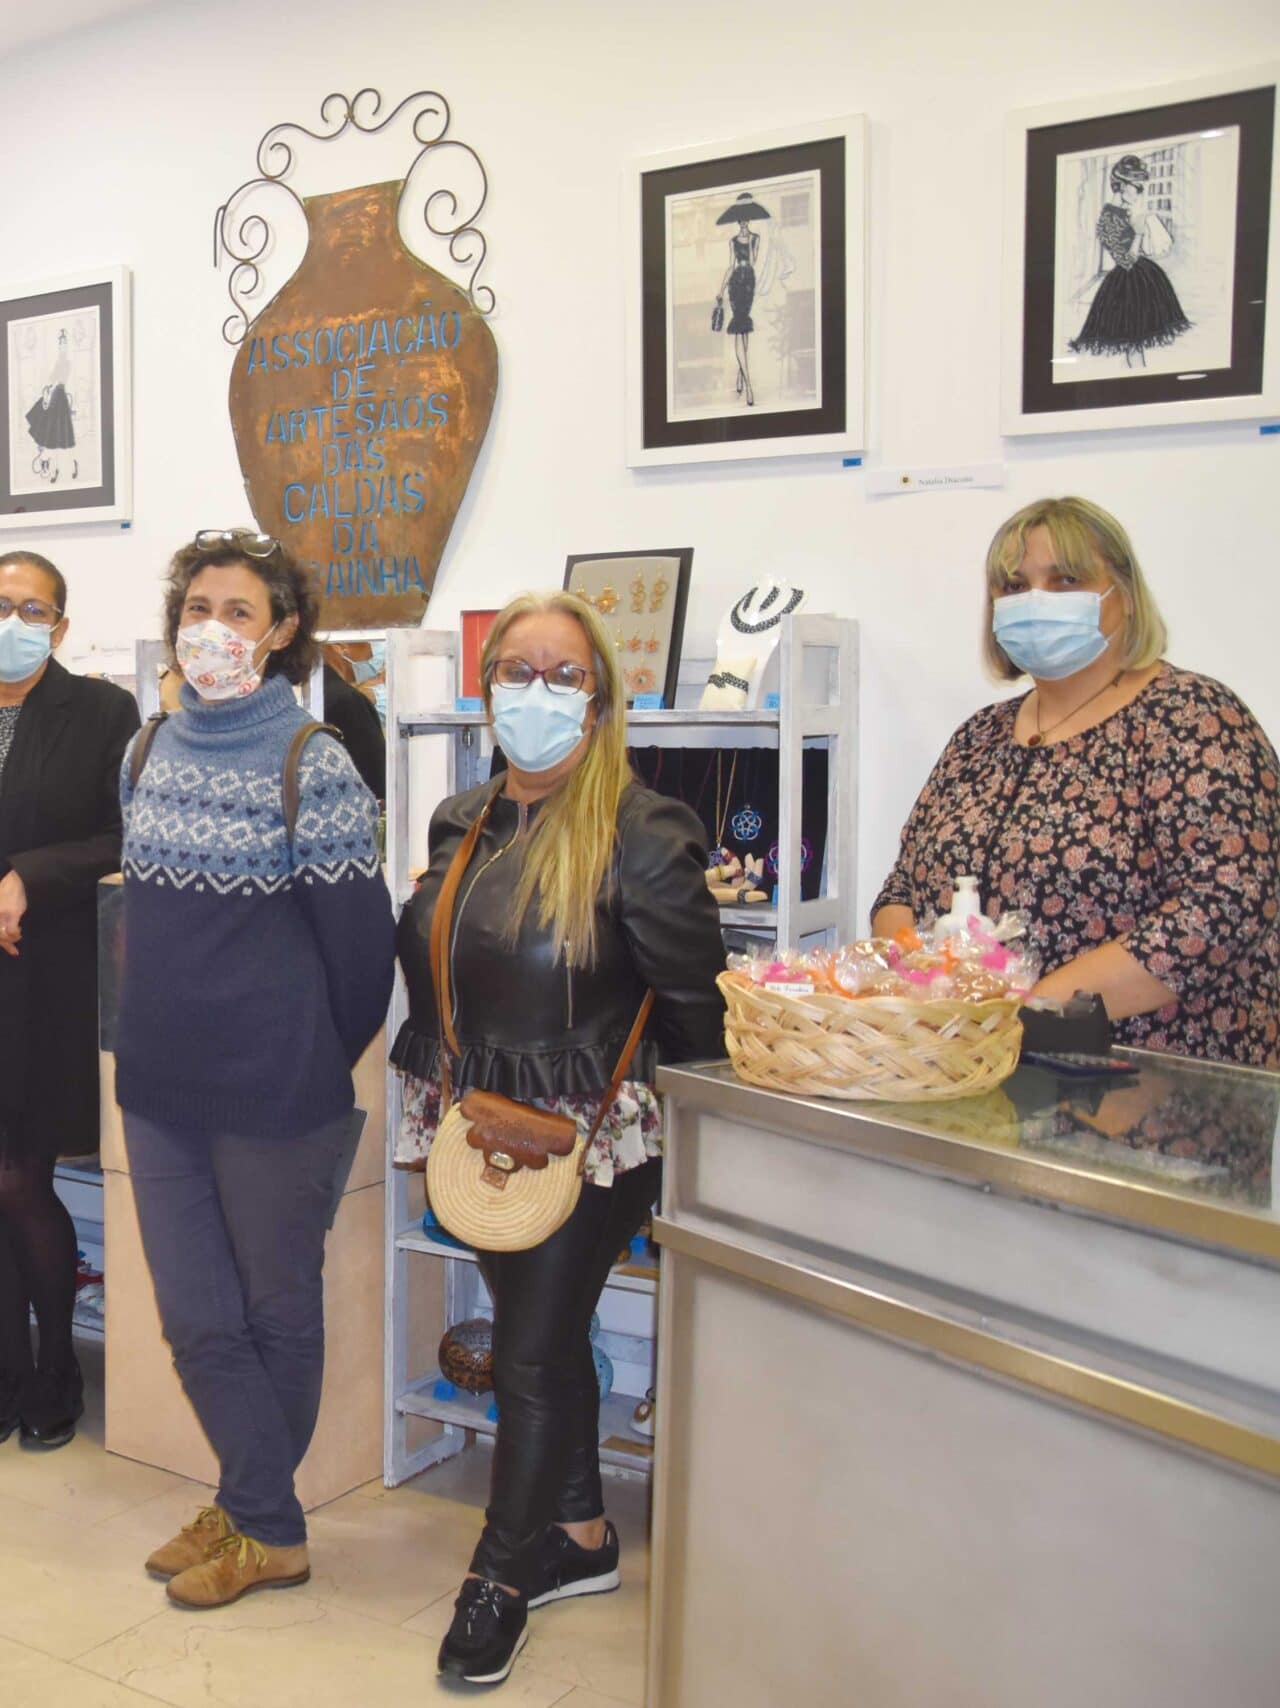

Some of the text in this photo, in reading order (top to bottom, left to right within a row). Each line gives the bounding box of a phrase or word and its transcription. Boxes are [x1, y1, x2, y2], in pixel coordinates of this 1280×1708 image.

[246, 301, 461, 376] ASSOCIAÇÃO
[331, 363, 376, 400] DE
[265, 388, 449, 445] ARTESÃOS
[322, 438, 386, 476] DAS
[283, 472, 425, 523] CALDAS
[333, 521, 379, 556] DA
